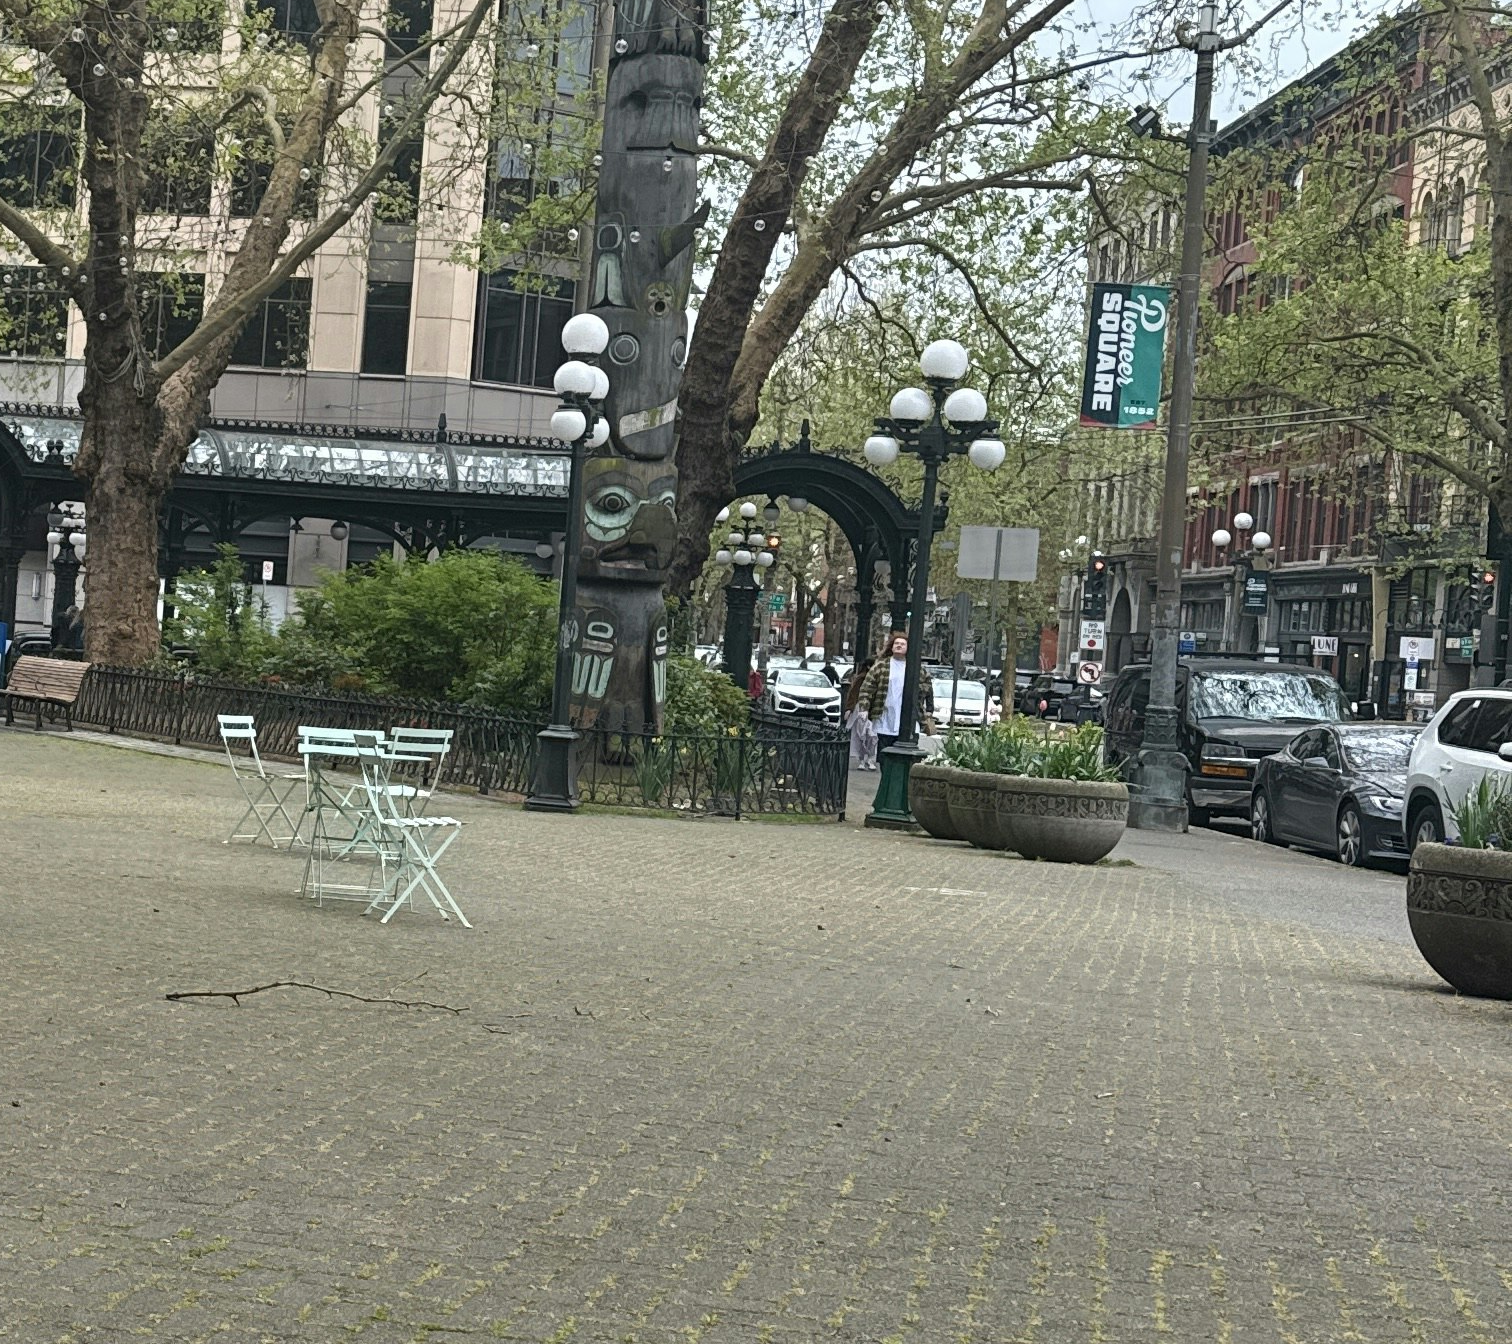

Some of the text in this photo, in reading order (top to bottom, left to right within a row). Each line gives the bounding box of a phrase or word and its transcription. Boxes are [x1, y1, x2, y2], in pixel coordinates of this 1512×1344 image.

[1092, 292, 1124, 412] SQUARE
[1116, 294, 1167, 388] Pioneer
[1123, 406, 1155, 416] 1852
